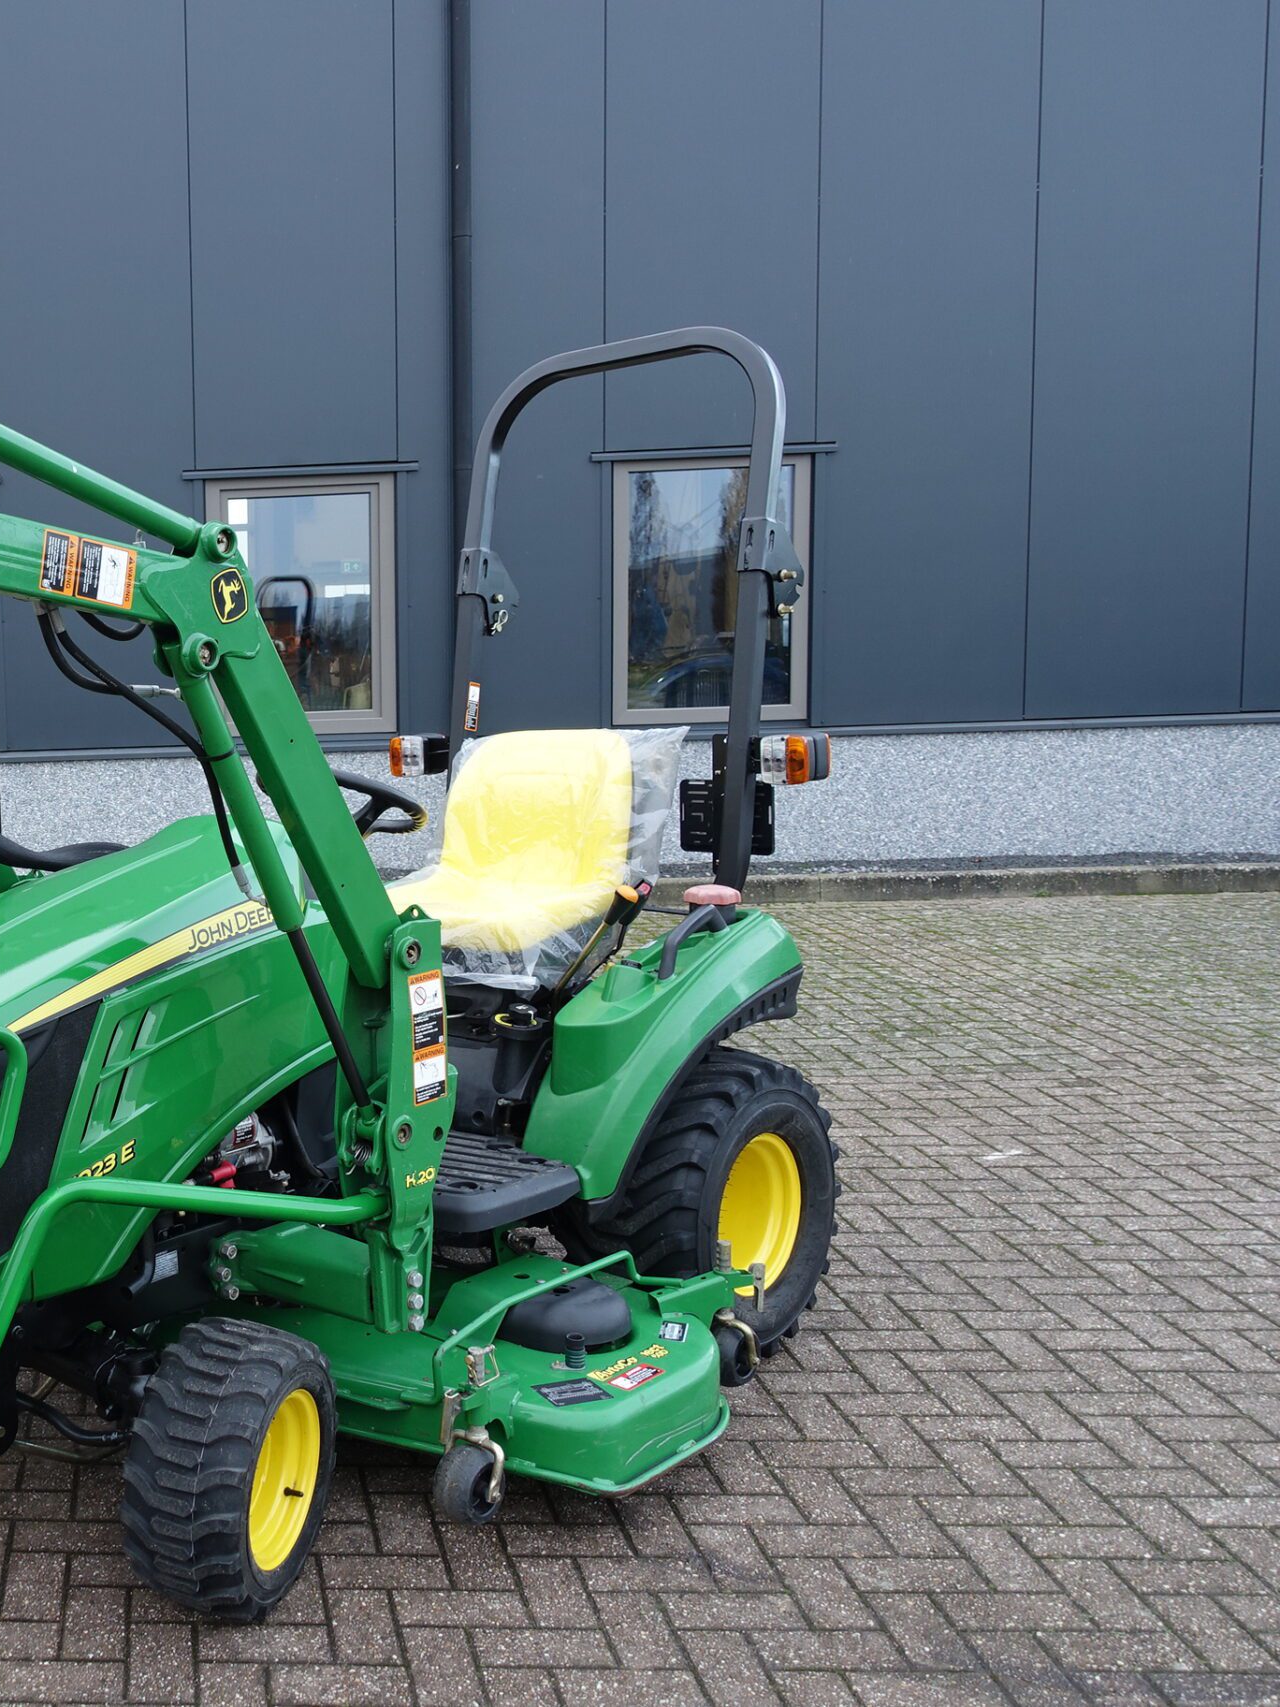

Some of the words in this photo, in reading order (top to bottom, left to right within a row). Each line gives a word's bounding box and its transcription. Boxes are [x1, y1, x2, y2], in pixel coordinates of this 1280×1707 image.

[65, 552, 74, 589] WARNING
[124, 566, 134, 602] WARNING
[188, 918, 233, 951] JOHN
[414, 971, 440, 985] WARNING
[419, 1048, 444, 1061] WARNING
[73, 1152, 117, 1178] 23
[121, 1139, 136, 1166] E
